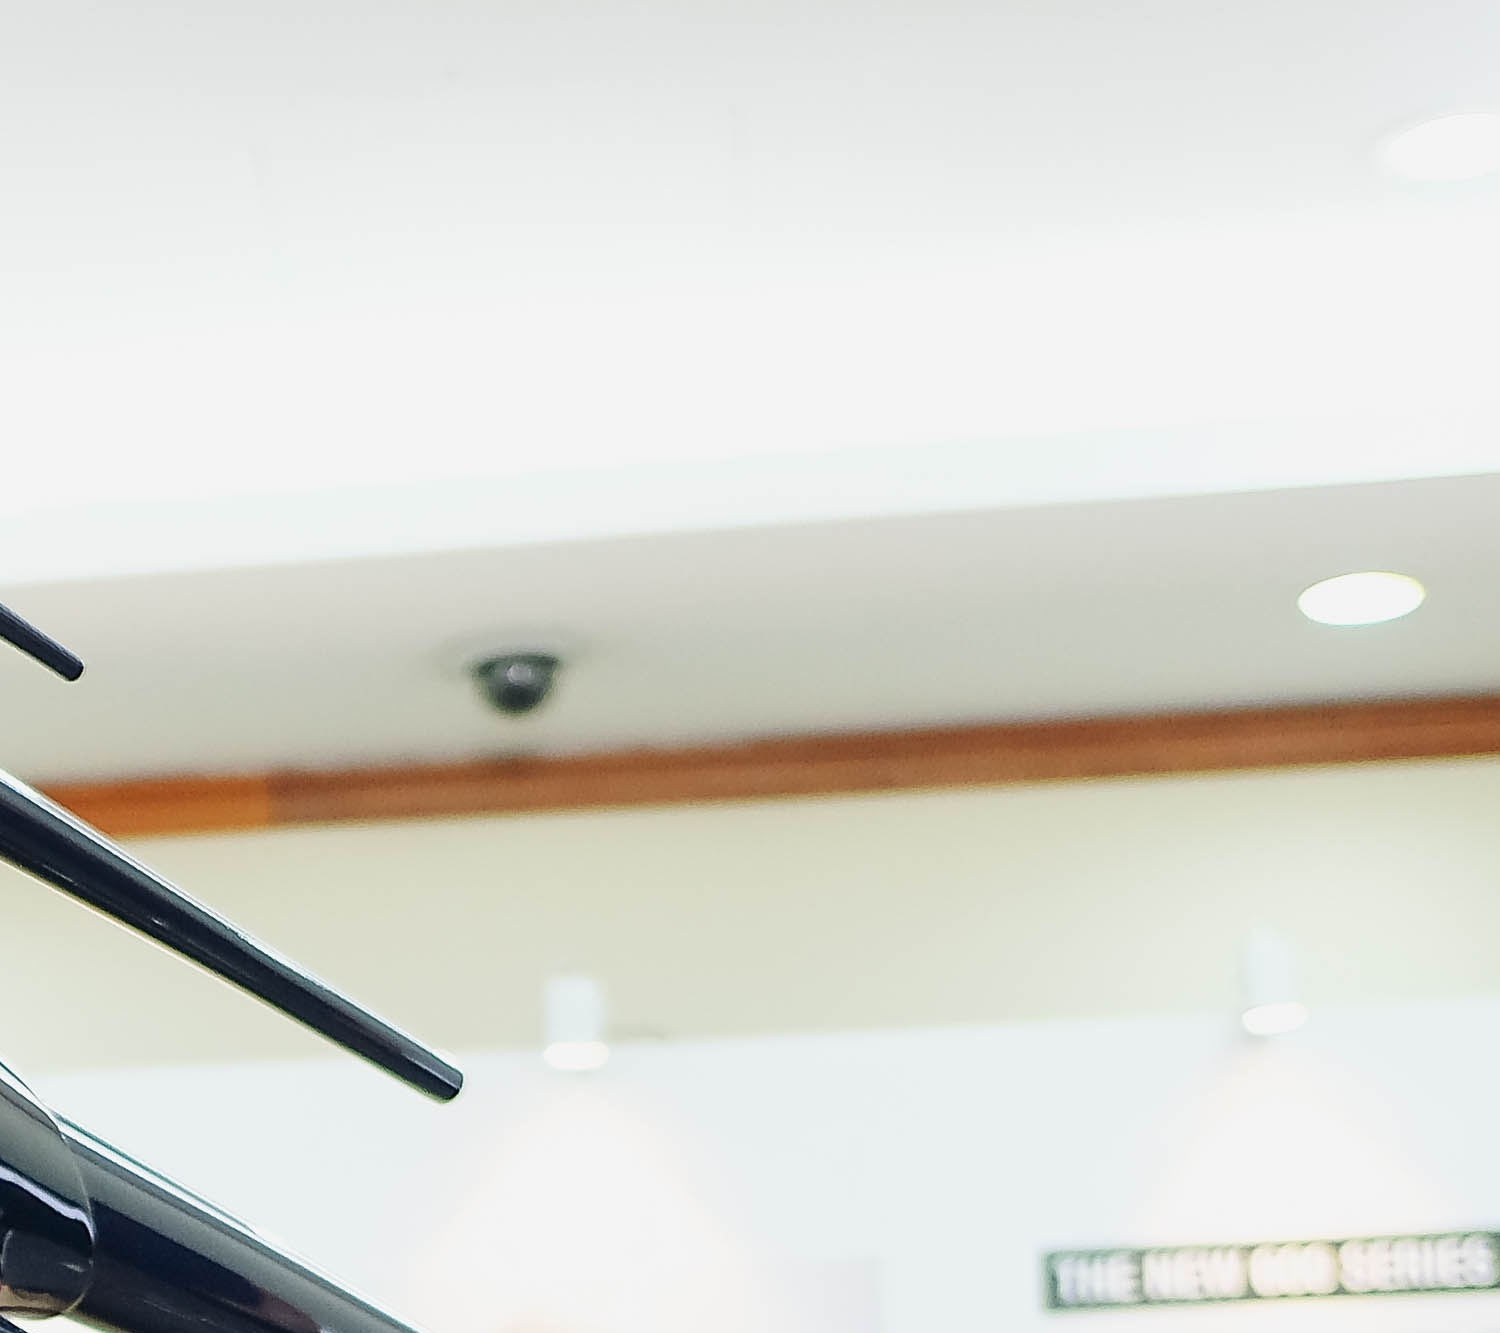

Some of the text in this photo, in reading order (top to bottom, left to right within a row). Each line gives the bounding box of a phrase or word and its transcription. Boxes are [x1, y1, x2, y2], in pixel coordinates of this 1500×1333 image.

[1056, 1256, 1140, 1301] THE
[1141, 1247, 1248, 1299] NEW
[1338, 1233, 1497, 1292] SERIES
